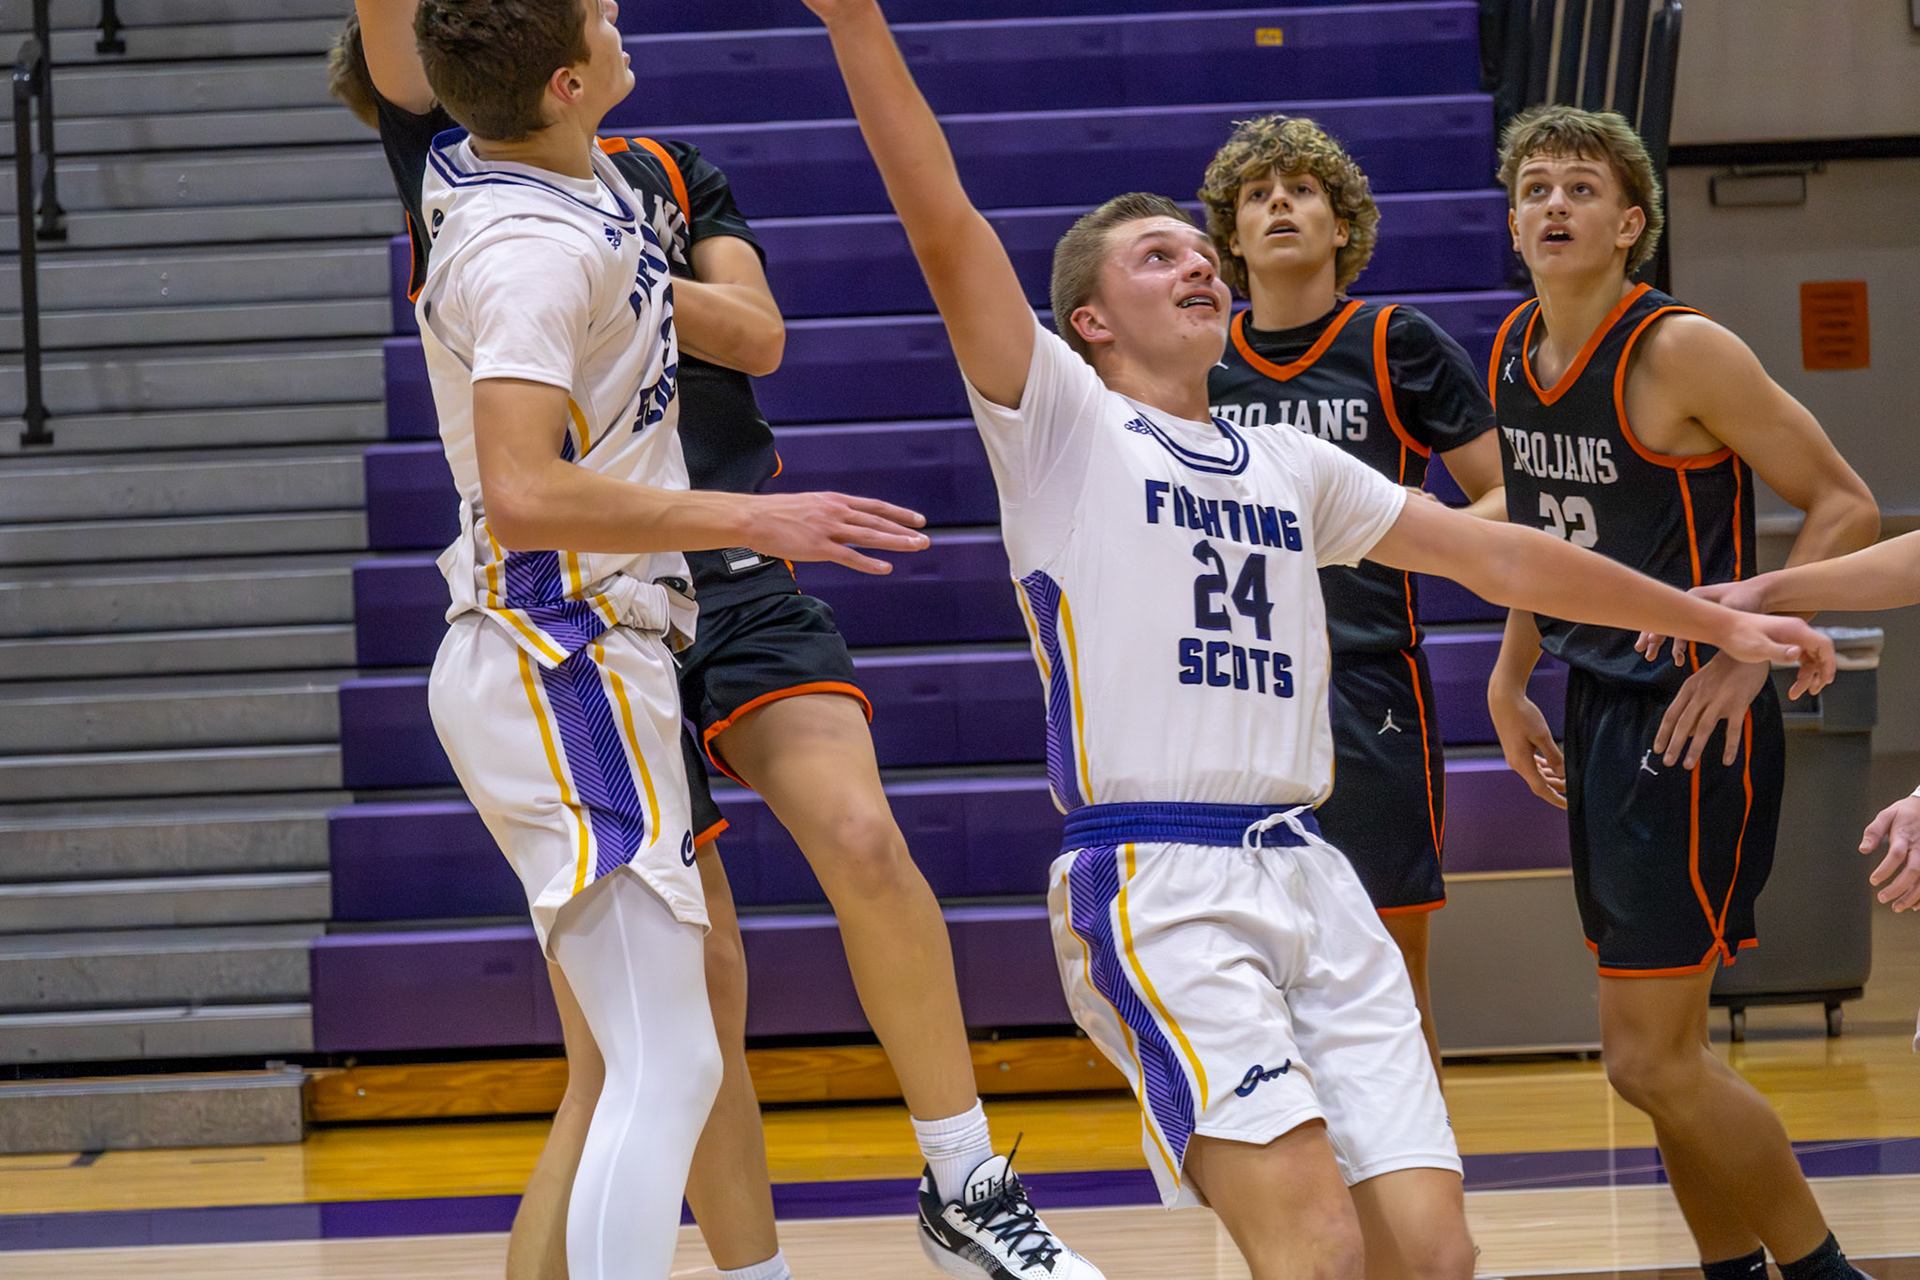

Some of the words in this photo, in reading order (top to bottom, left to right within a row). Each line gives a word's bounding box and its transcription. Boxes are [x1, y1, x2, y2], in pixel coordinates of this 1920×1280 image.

[1501, 425, 1619, 485] TROJANS
[1192, 539, 1275, 641] 24
[1179, 637, 1294, 698] SCOTS
